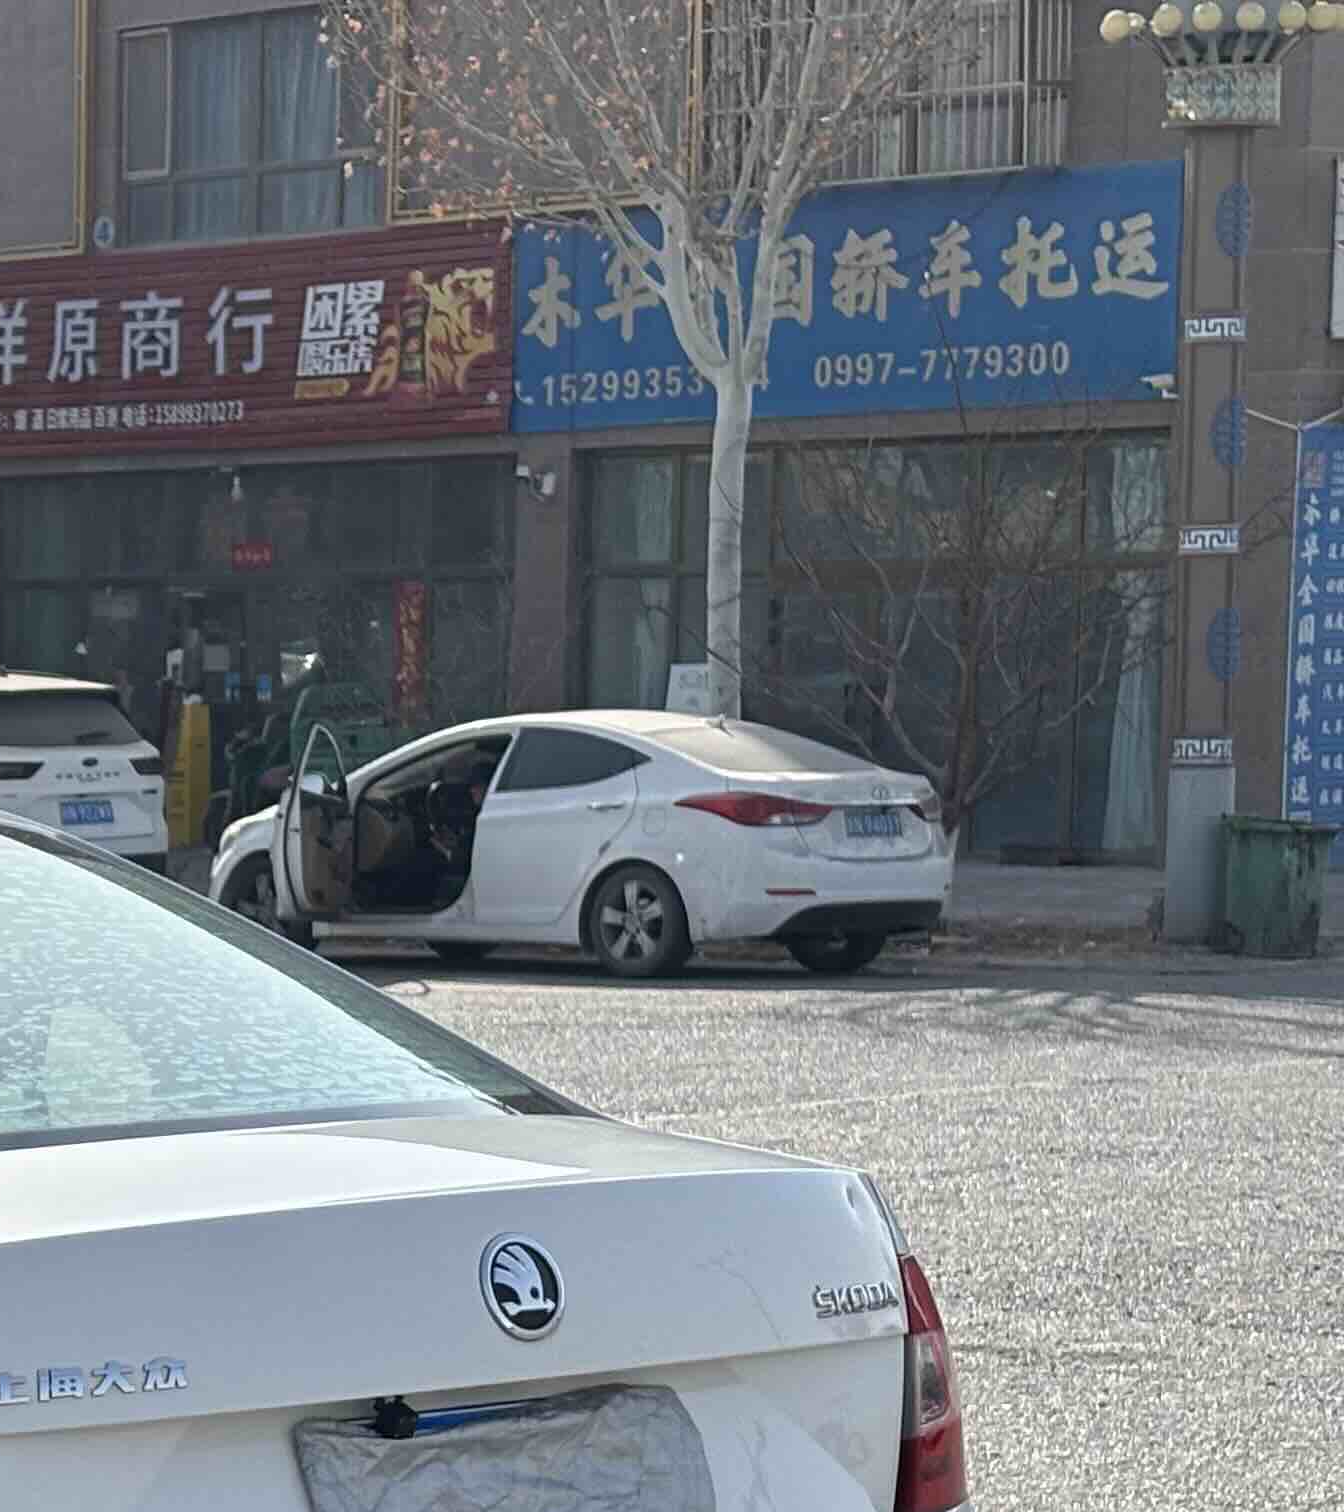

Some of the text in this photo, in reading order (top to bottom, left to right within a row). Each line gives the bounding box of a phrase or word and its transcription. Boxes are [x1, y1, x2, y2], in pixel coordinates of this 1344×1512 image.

[520, 211, 1170, 348] 木华国轿车托运
[543, 340, 1072, 406] 152993534 0997-7779300
